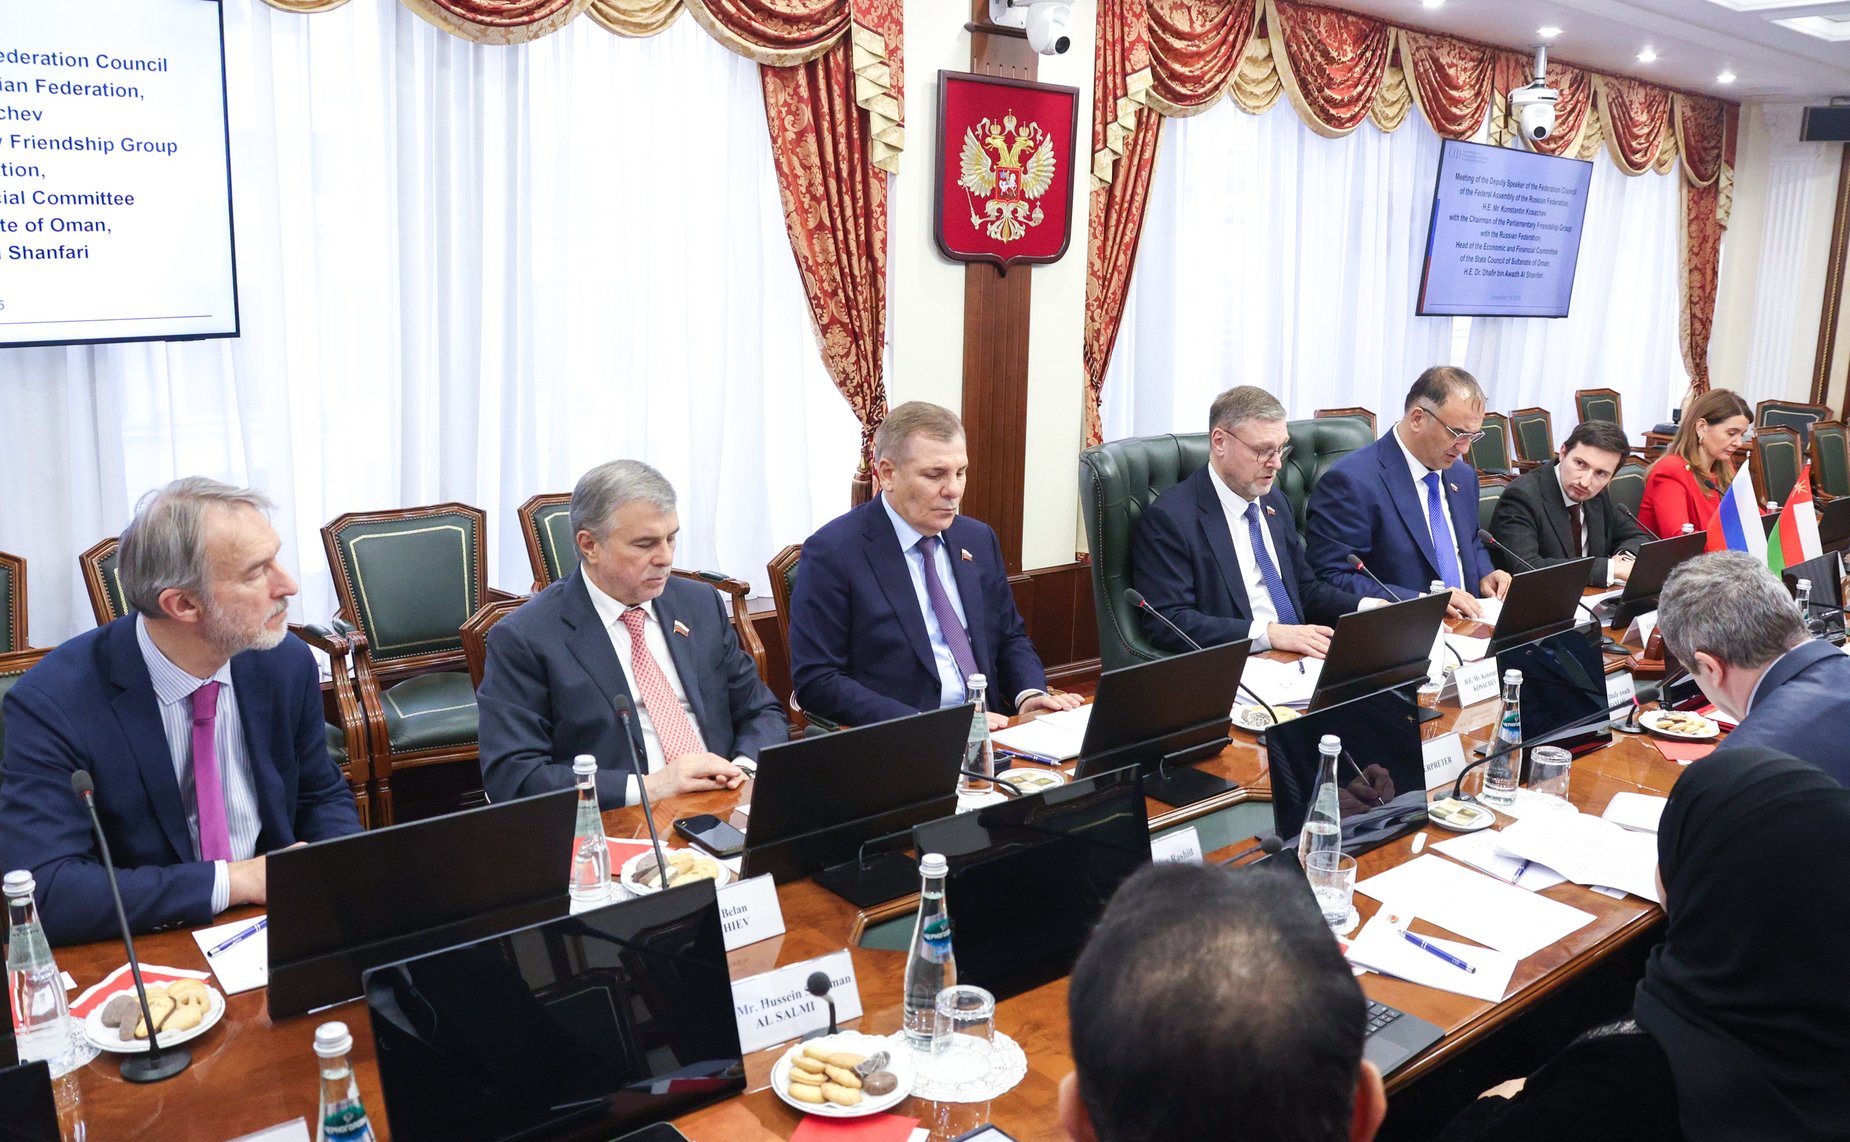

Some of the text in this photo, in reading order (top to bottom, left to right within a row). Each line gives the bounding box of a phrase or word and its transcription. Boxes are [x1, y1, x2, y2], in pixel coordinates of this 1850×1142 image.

[96, 53, 169, 72] Council
[35, 79, 145, 100] Federation,
[10, 134, 115, 155] Friendship
[120, 137, 178, 156] Group
[1455, 172, 1475, 185] Meeting
[1490, 177, 1506, 188] Deputy
[1507, 180, 1525, 189] Speaker
[1539, 184, 1561, 194] Federation
[0, 190, 135, 206] ial Committee
[1474, 189, 1492, 198] Federal
[1493, 192, 1515, 202] Assembly
[1529, 196, 1546, 204] Russian
[1501, 206, 1526, 215] Konstantin
[25, 217, 44, 233] of
[50, 217, 112, 235] Oman,
[1470, 215, 1492, 224] Chairman
[1506, 218, 1536, 230] Parliamentary
[1500, 230, 1518, 240] Russian
[8, 245, 89, 260] Shanfari
[1456, 240, 1468, 249] Head
[1484, 243, 1506, 252] Economic
[1516, 245, 1536, 254] Financial
[1474, 255, 1487, 264] State
[1488, 256, 1505, 264] Council
[1511, 258, 1532, 266] Sultanate
[1482, 268, 1496, 277] Dhafir
[1505, 270, 1520, 278] Awadh
[1170, 848, 1194, 864] Rashid
[721, 904, 748, 919] Belan
[723, 917, 750, 934] HIEV
[736, 1003, 759, 1018] Mr.
[760, 990, 802, 1010] Hussein
[756, 1000, 816, 1030] AL SALMI
